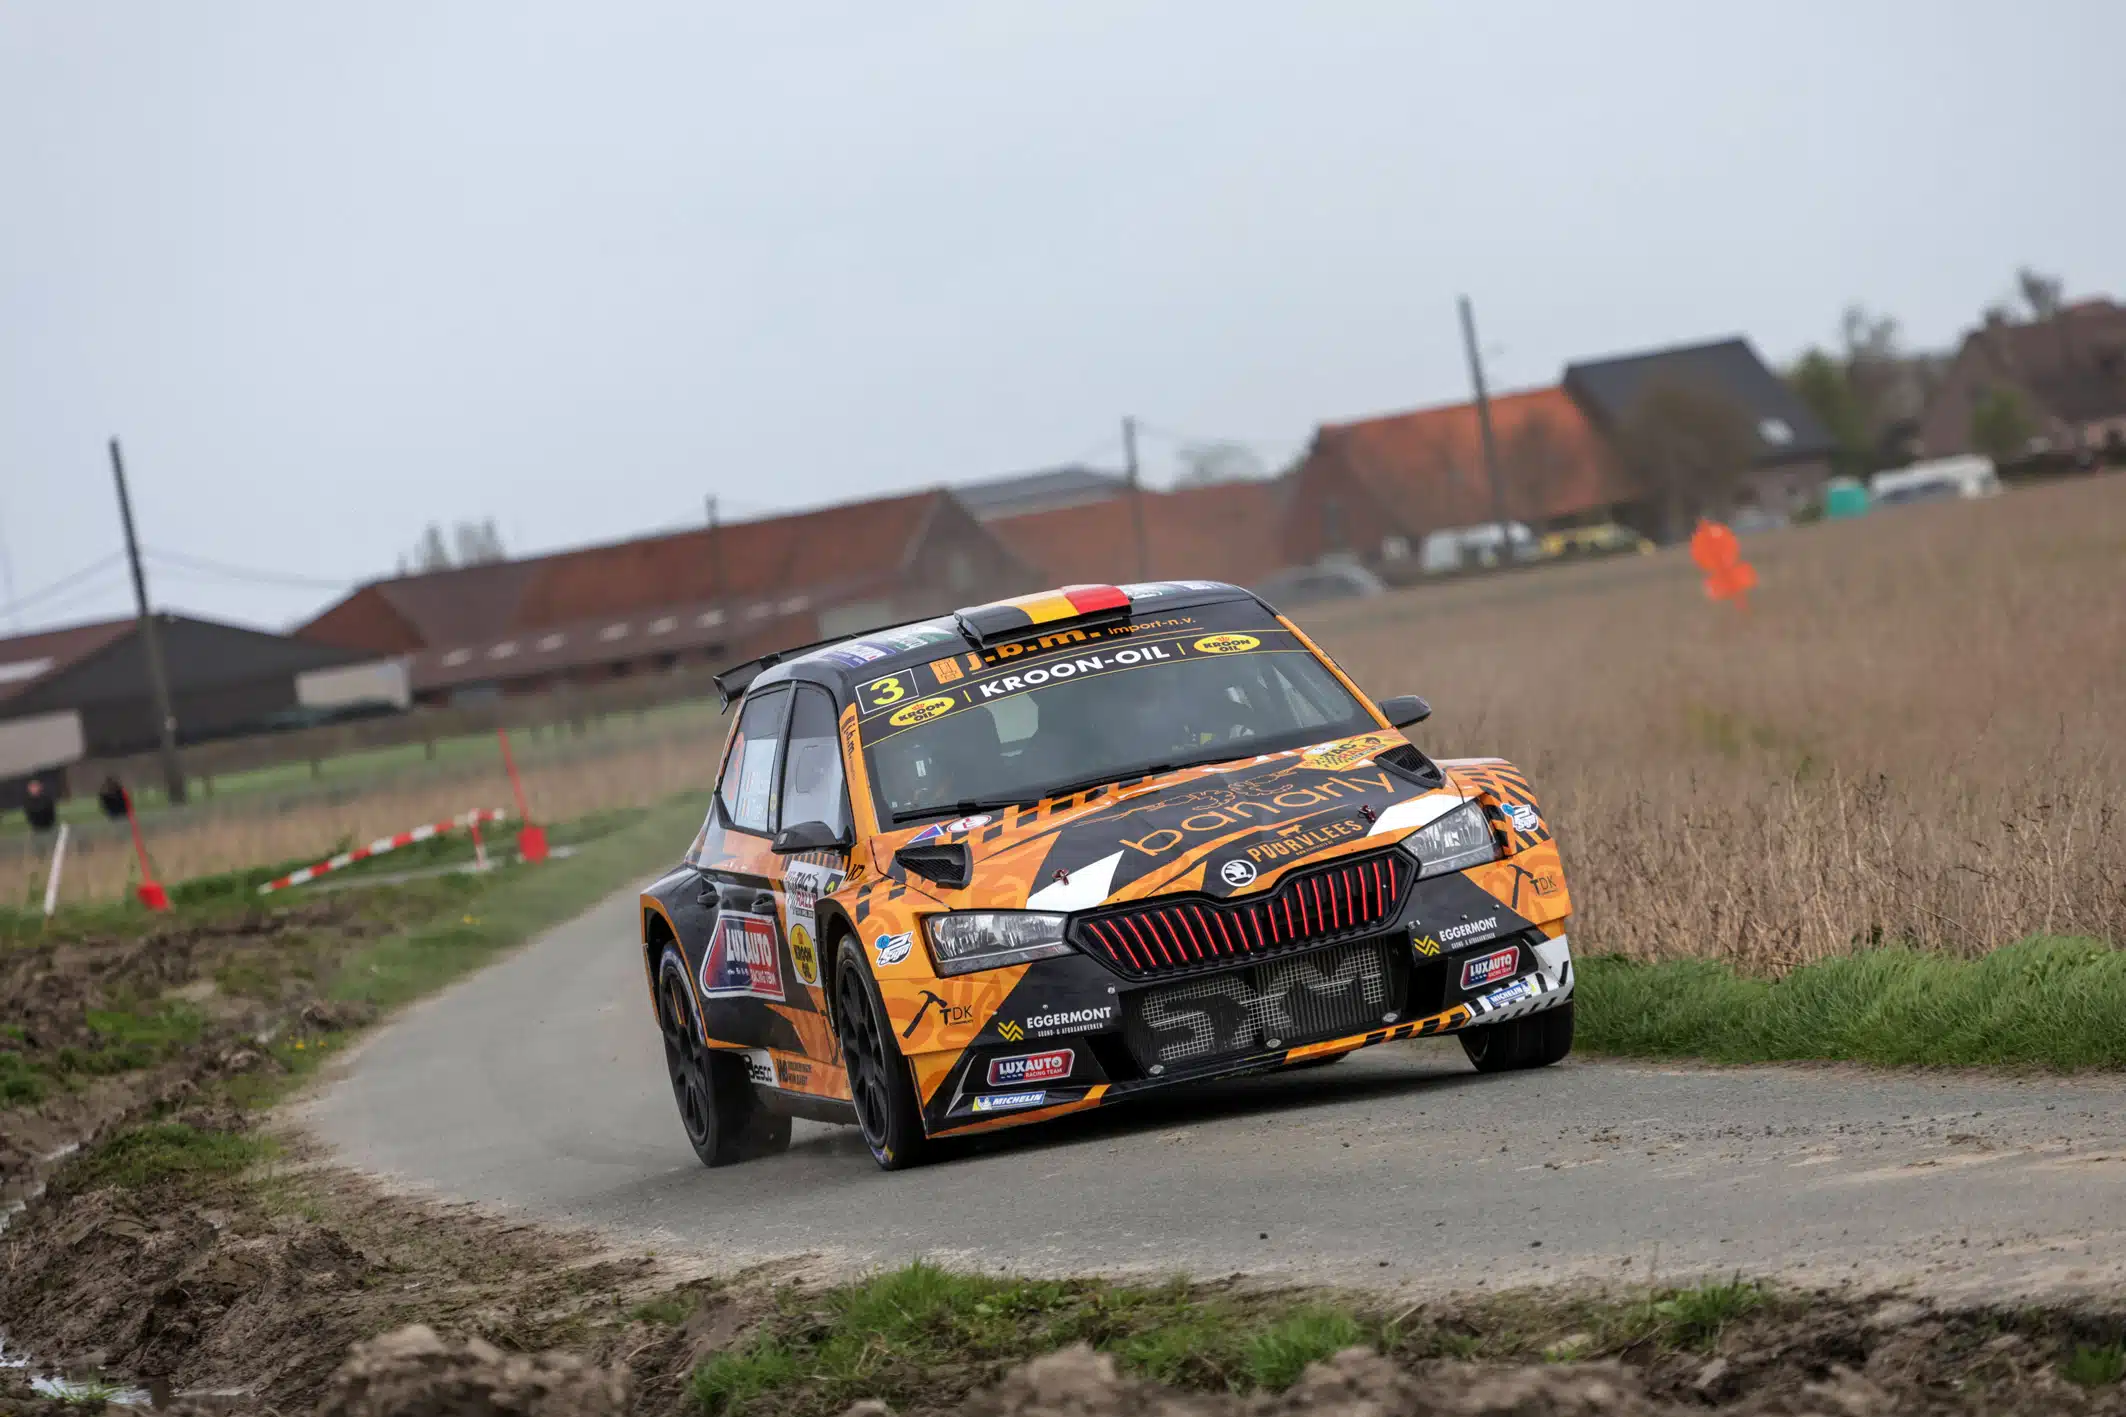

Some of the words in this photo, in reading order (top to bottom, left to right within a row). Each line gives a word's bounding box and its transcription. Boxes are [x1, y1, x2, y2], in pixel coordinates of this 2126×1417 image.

[1107, 617, 1196, 635] import-n.v.
[1203, 639, 1251, 649] KROON
[979, 646, 1171, 698] KROON-OIL
[870, 678, 905, 705] 3
[898, 701, 946, 721] KROON
[914, 712, 935, 722] OIL
[1120, 772, 1396, 857] banarly
[1246, 820, 1363, 863] PUURVLEES
[1530, 875, 1557, 896] TDK
[1439, 917, 1498, 942] EGGERMONT
[726, 929, 773, 967] LUXAUTO
[1470, 954, 1512, 977] LUXAUTO
[1490, 986, 1523, 1002] MICHELIN
[940, 1004, 973, 1026] TDK
[1027, 1007, 1112, 1029] EGGERMONT
[999, 1056, 1062, 1075] LUXAUTO
[1026, 1070, 1046, 1078] RACING
[992, 1094, 1043, 1106] MICHELIN
